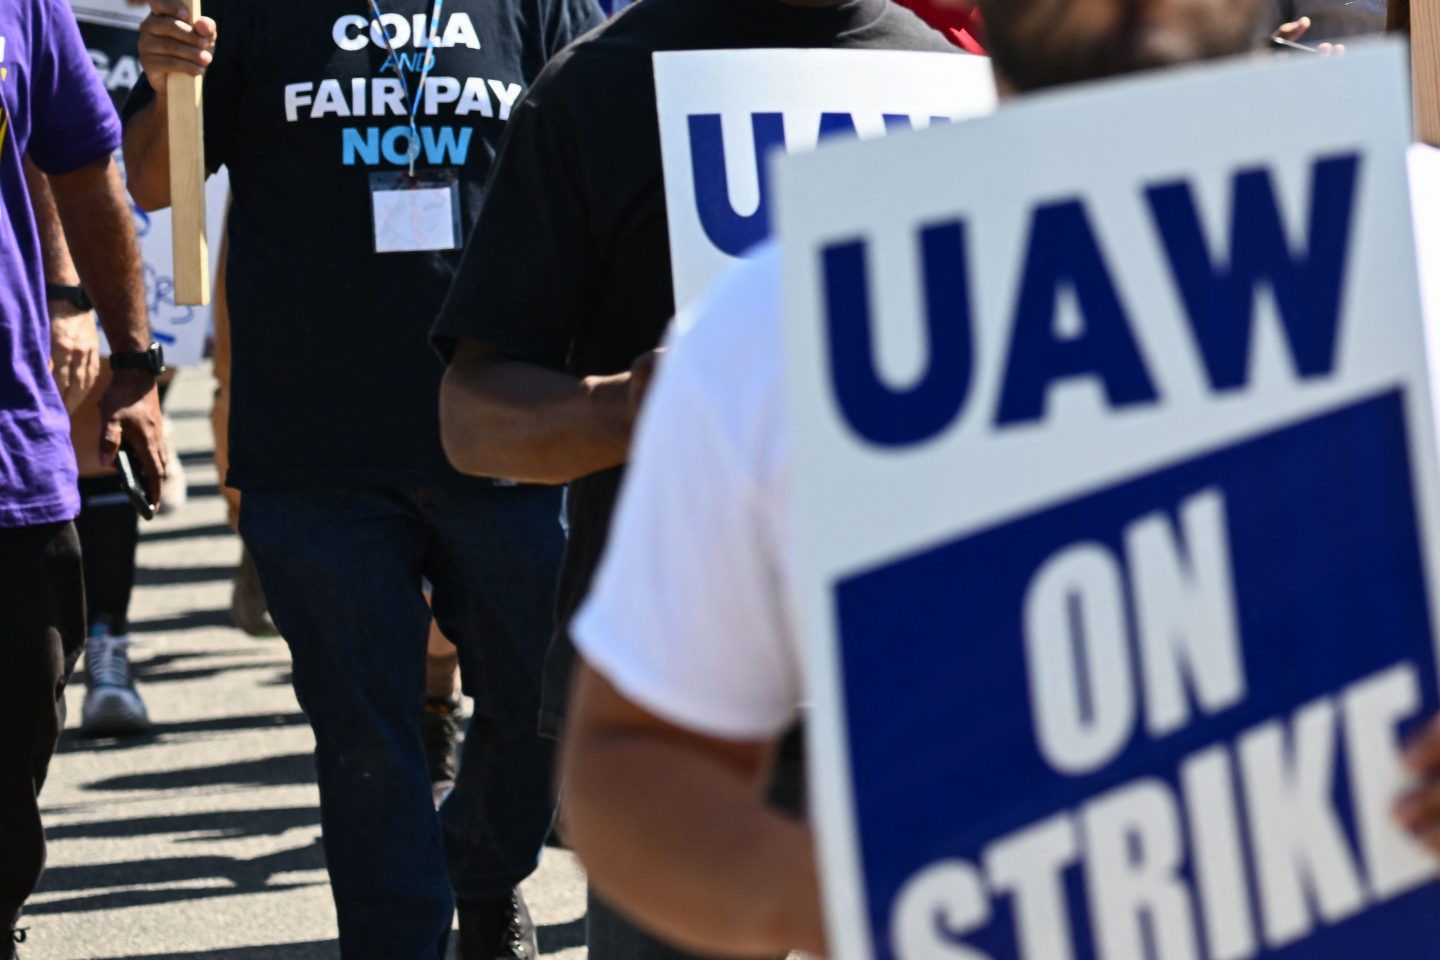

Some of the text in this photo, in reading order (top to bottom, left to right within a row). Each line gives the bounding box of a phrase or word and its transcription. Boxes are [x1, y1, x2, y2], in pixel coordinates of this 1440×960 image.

[332, 12, 481, 51] COLA
[379, 52, 436, 73] AND
[284, 76, 523, 122] FAIR PAY
[342, 126, 473, 166] NOW
[816, 148, 1367, 456] UAW
[1023, 486, 1247, 777] ON
